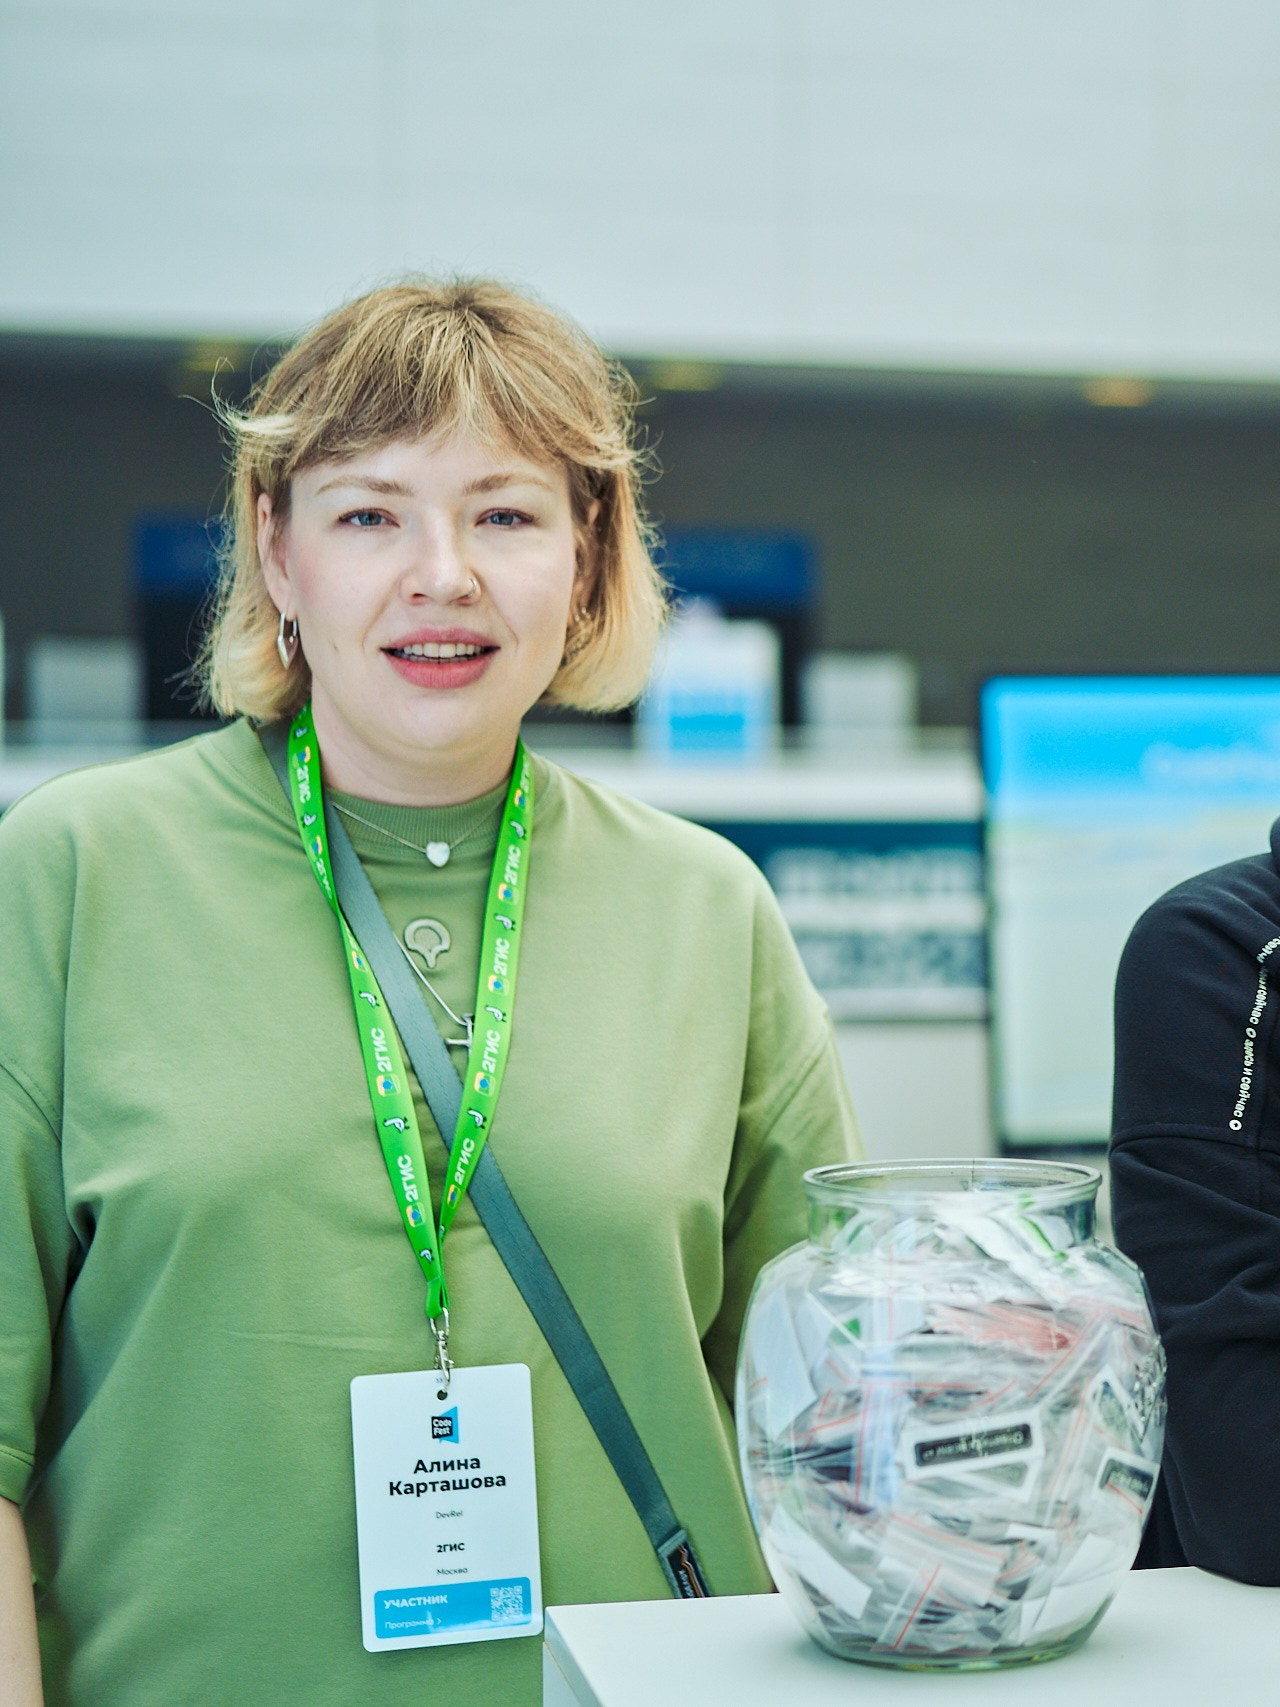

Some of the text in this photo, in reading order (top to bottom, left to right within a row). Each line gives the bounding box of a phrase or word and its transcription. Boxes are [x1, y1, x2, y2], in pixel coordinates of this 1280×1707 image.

[296, 765, 312, 804] 2ГИС
[505, 845, 521, 886] 2ГИС
[493, 938, 511, 976] 2ГИС
[372, 1028, 393, 1073] 2ГИС
[482, 1029, 500, 1073] 2ГИС
[1233, 1077, 1251, 1117] сейчас
[454, 1138, 475, 1185] 2ГИС
[398, 1154, 418, 1202] 2ГИС
[433, 1419, 452, 1427] Code
[433, 1427, 451, 1436] Fest
[413, 1457, 481, 1475] Алина
[389, 1475, 507, 1498] Карташова
[436, 1510, 463, 1519] DevRel
[437, 1542, 465, 1553] 2ГИС
[437, 1567, 468, 1576] Москва
[384, 1595, 448, 1609] УЧАСТНИК
